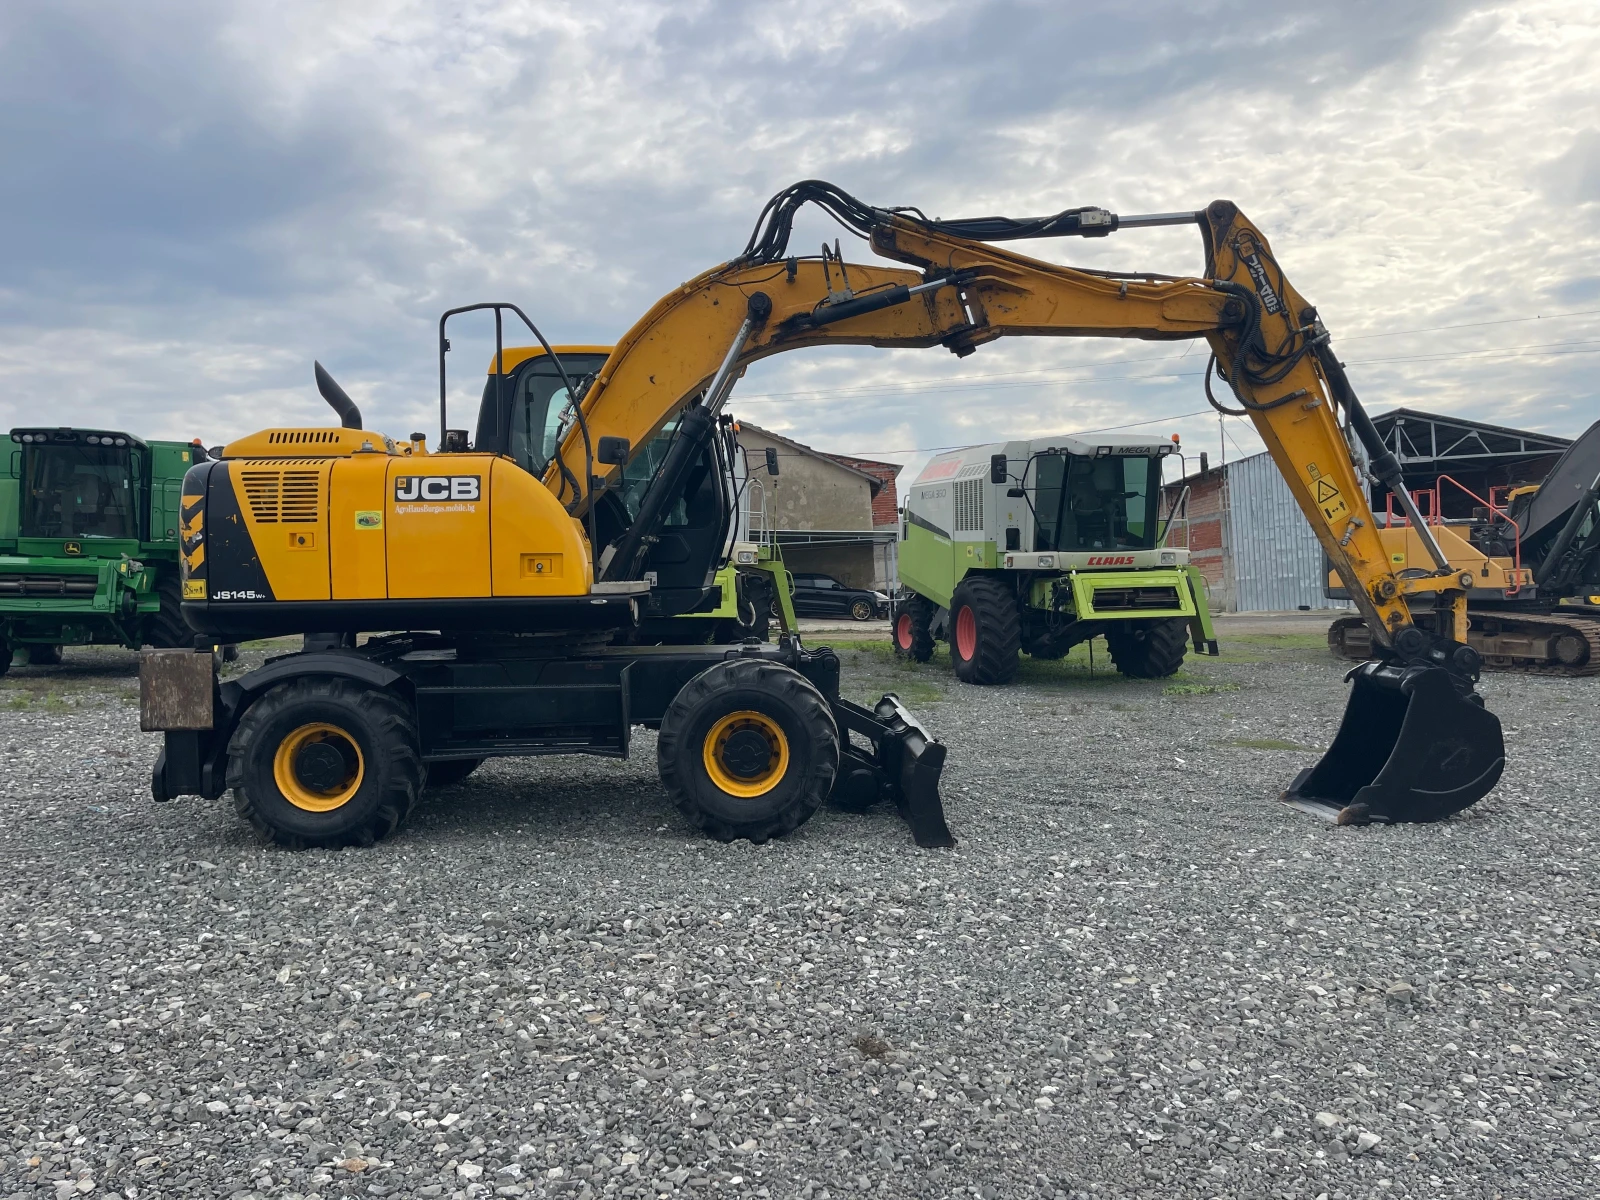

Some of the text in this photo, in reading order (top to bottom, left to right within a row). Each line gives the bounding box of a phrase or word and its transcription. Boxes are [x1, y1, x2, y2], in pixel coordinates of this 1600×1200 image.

[1118, 446, 1150, 454] MEGA
[397, 477, 479, 500] JCB
[920, 490, 935, 500] MEGA
[395, 504, 475, 514] AgroHausBurgas.mobile.bg
[1087, 556, 1135, 566] CLAAS
